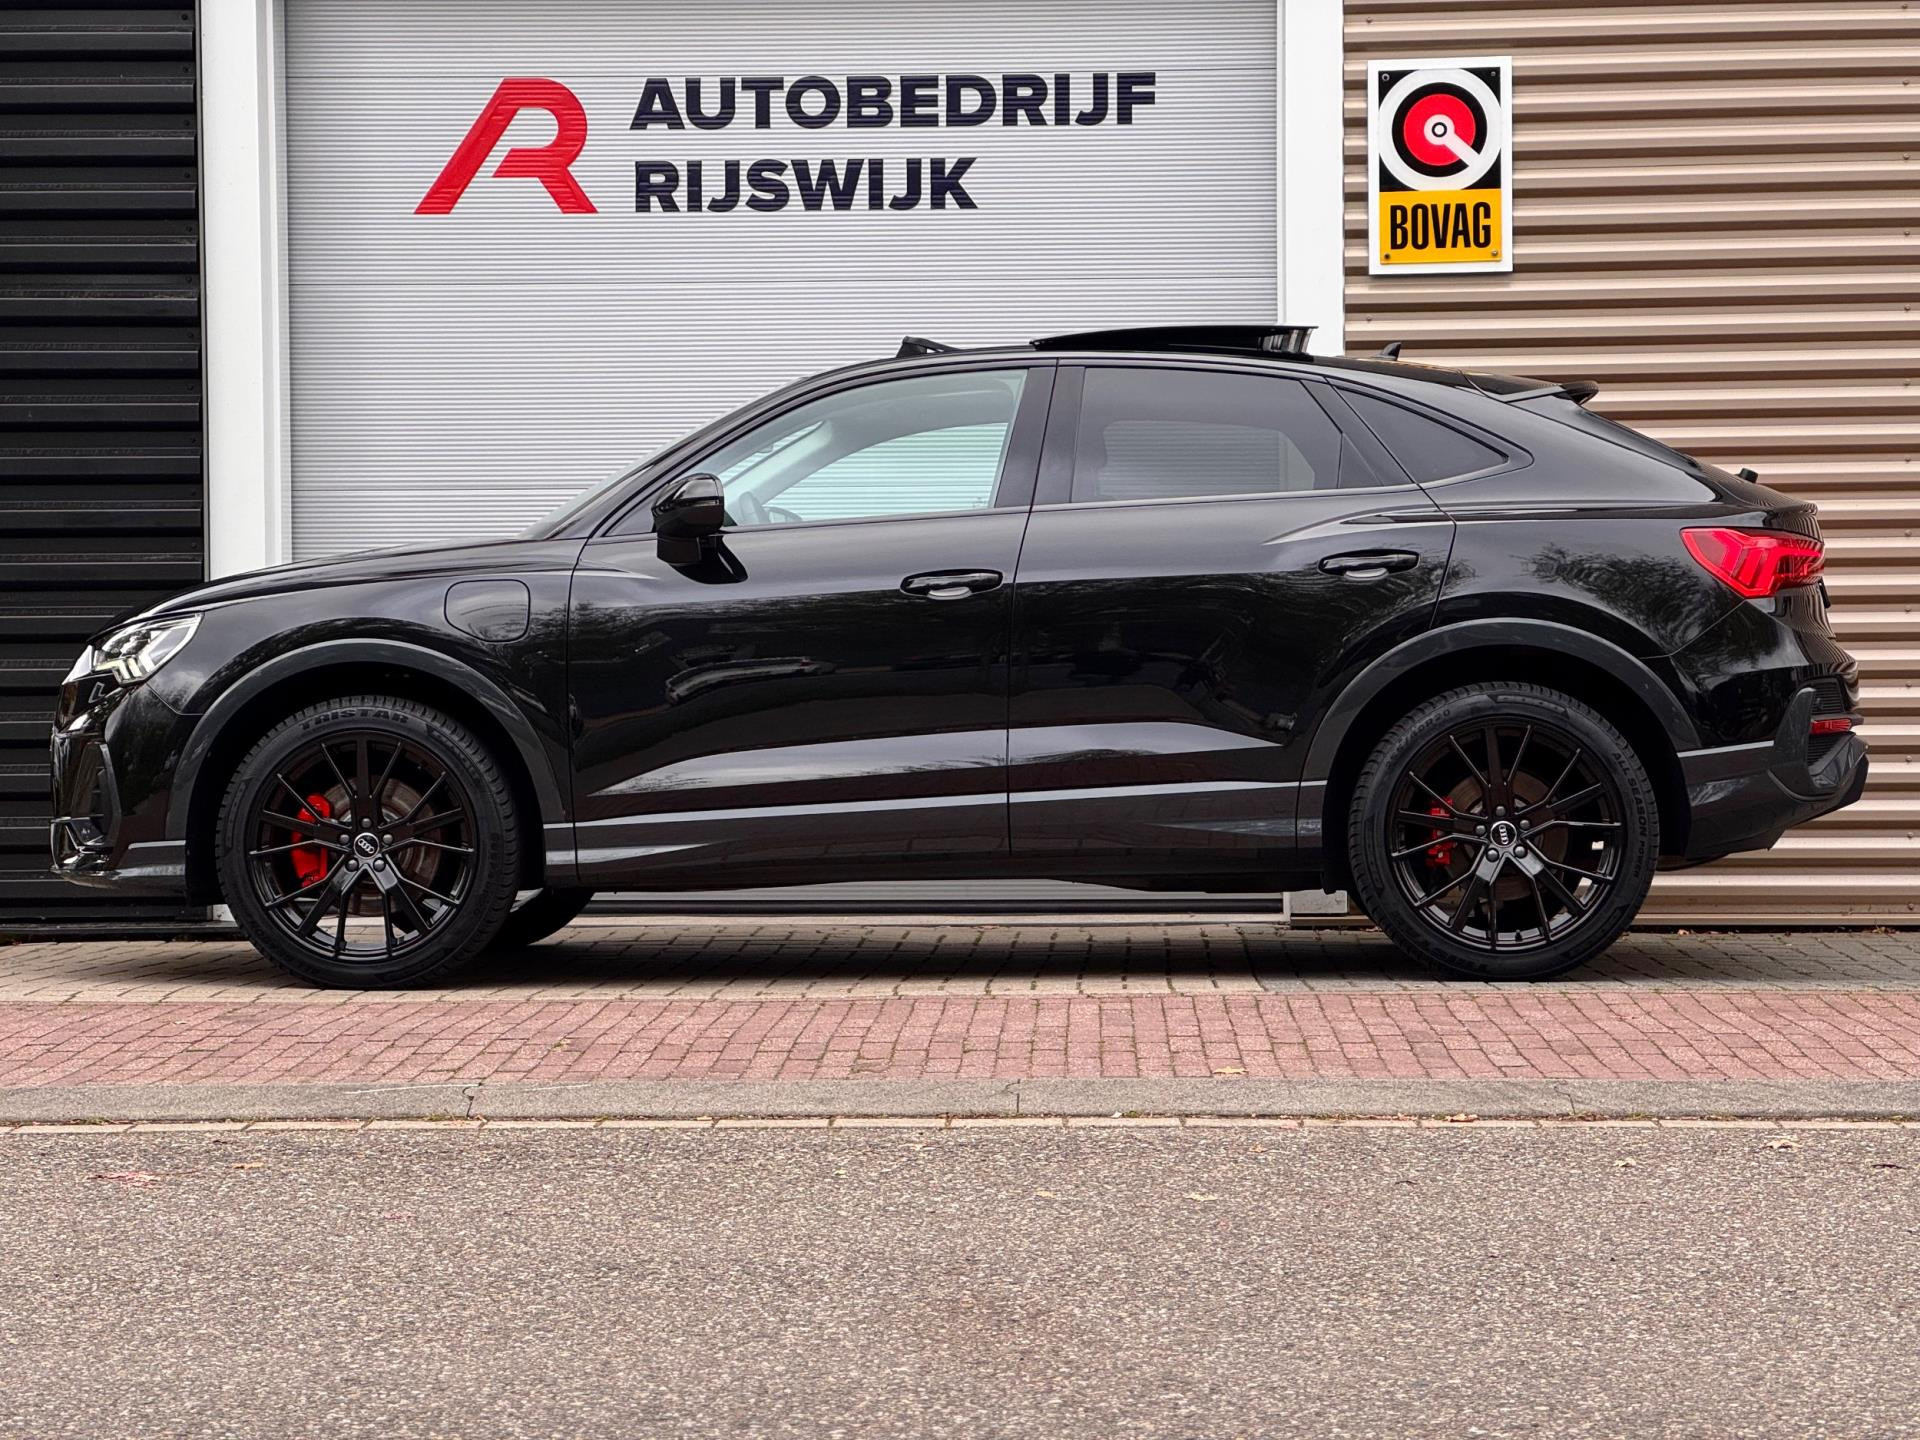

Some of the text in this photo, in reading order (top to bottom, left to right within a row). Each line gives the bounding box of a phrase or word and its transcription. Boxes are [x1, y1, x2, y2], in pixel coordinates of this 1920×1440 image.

[629, 72, 1156, 131] AUTOBEDRIJF
[634, 157, 978, 213] RIJSWIJK
[1390, 202, 1492, 250] BOVAG
[299, 708, 409, 730] TRISTAR
[1611, 752, 1630, 776] ALL
[1627, 777, 1648, 837] SEASON
